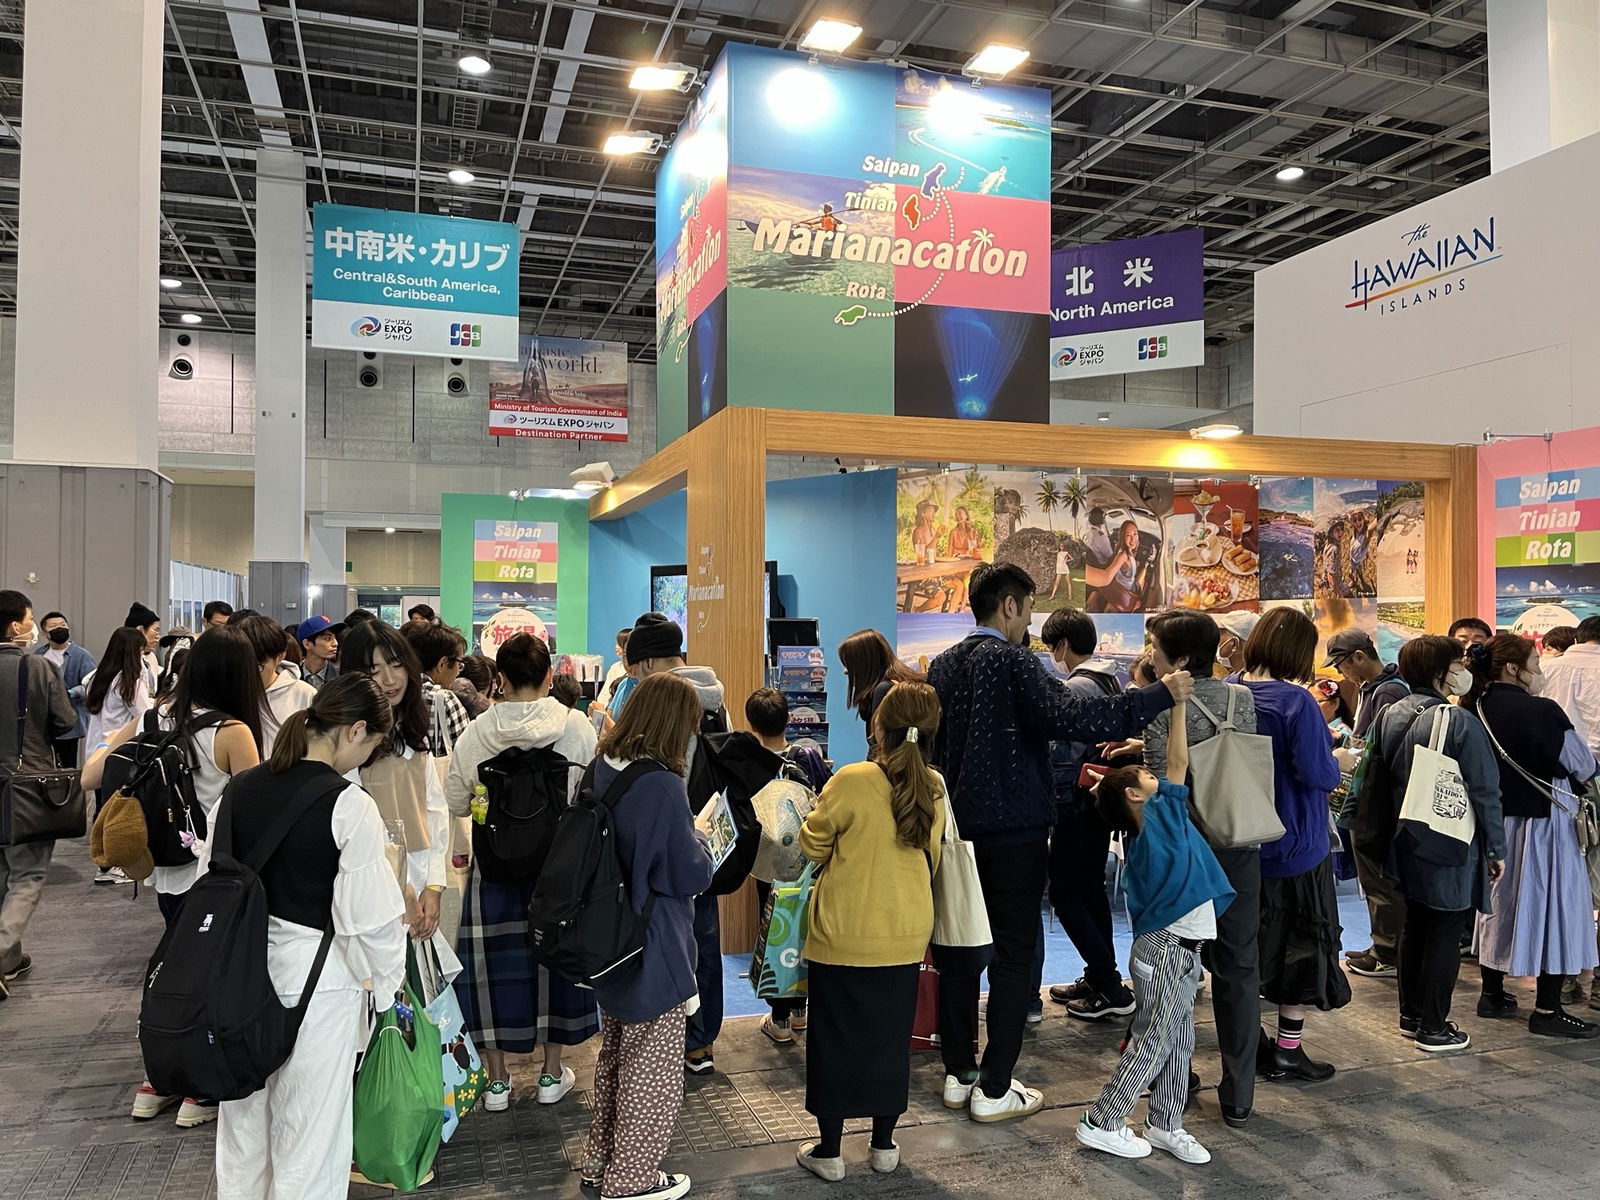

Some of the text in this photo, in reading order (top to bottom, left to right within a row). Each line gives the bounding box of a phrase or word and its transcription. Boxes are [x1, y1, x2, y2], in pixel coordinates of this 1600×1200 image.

[862, 154, 920, 178] Saipan
[844, 191, 898, 213] Tinian
[1401, 223, 1431, 246] the
[325, 226, 511, 272] 中南米・カリブ
[752, 218, 1028, 278] Marianacation
[1351, 216, 1494, 311] HAWAIIAN
[333, 268, 501, 295] Central&South America,
[845, 282, 887, 300] Rota
[383, 286, 453, 303] Caribbean
[1380, 278, 1466, 315] ISLANDS
[1050, 295, 1175, 322] North America
[384, 324, 413, 335] EXPO
[384, 333, 413, 341] ジャパン
[450, 327, 481, 343] JCB
[1080, 349, 1104, 359] EXPO
[1138, 340, 1167, 357] JCB
[494, 403, 521, 411] Ministry
[515, 429, 603, 441] Destination Partner
[1519, 477, 1581, 499] Saipan
[1519, 509, 1581, 532] Tinian
[494, 524, 542, 540] Saipan
[494, 545, 542, 559] Tinian
[1525, 538, 1572, 560] Rota
[498, 565, 534, 578] Rota
